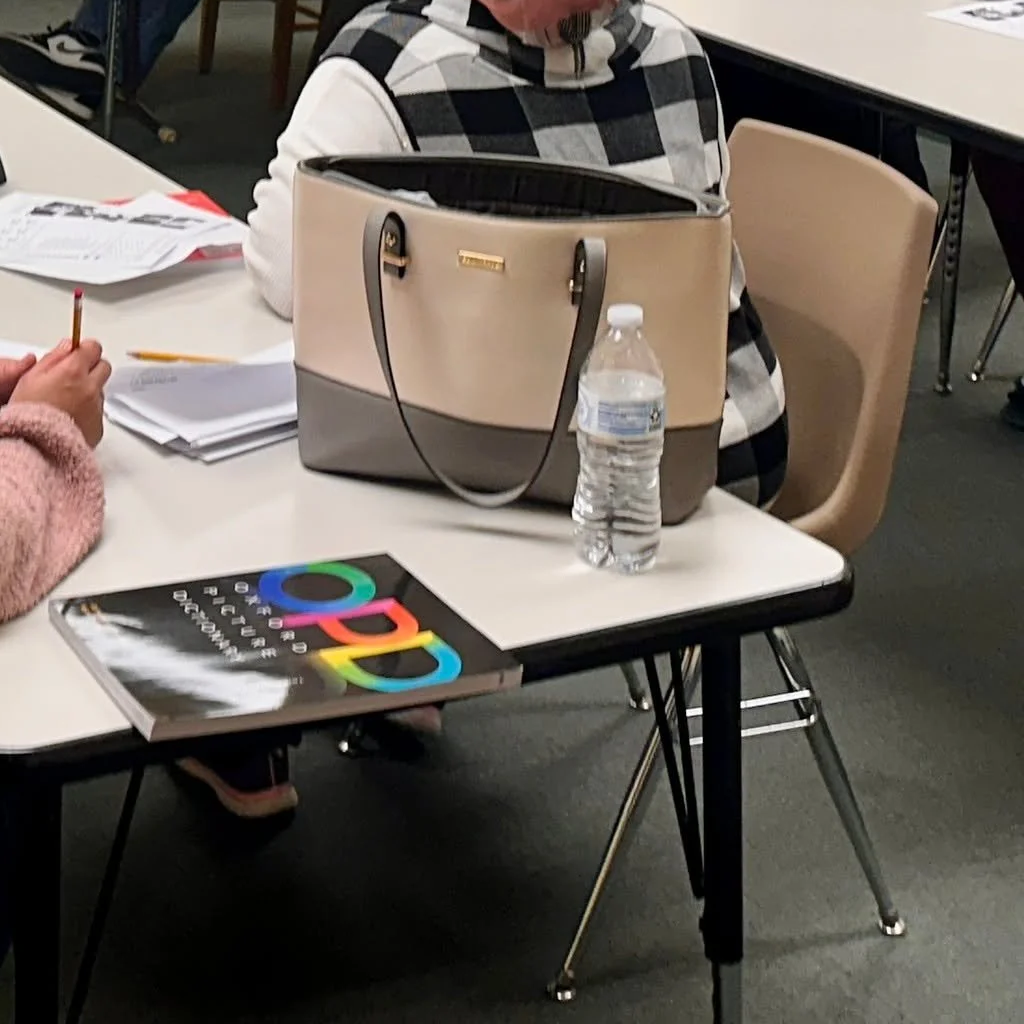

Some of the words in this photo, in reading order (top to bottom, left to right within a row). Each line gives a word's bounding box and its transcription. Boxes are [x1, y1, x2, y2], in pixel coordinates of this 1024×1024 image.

[203, 585, 277, 659] PICTURE
[234, 581, 308, 654] OXFORD
[258, 561, 462, 692] OPD
